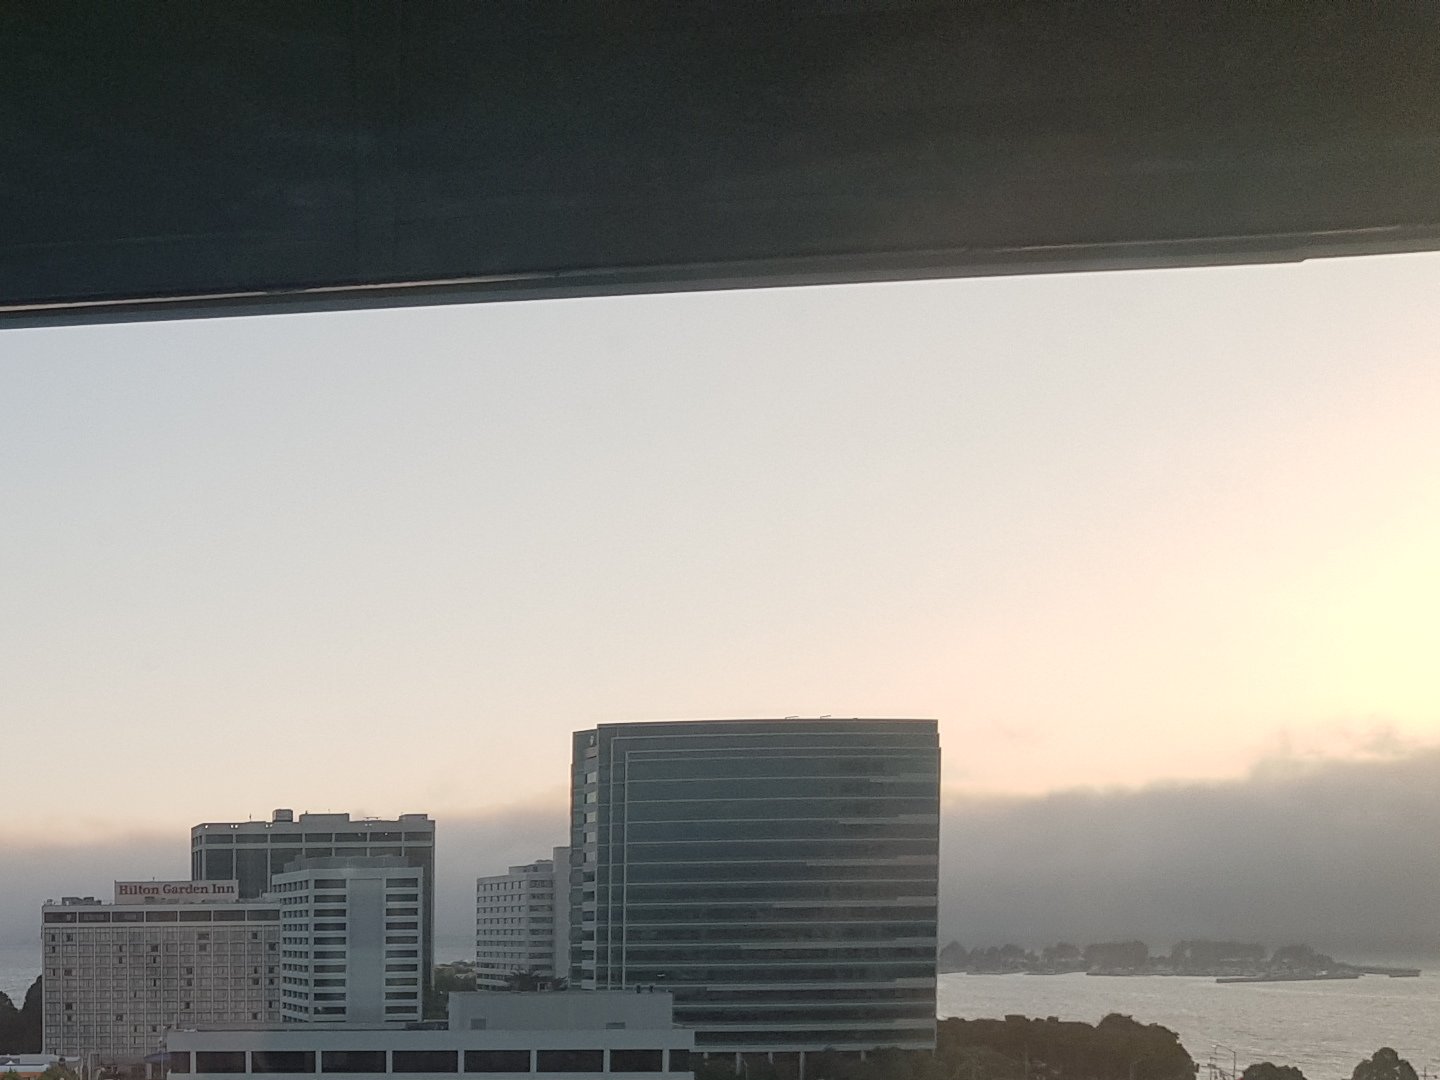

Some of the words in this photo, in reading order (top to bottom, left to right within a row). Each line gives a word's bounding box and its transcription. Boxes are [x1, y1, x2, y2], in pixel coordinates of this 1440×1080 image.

[119, 885, 159, 895] Hilton
[163, 884, 208, 894] Garden
[212, 884, 235, 894] Inn
